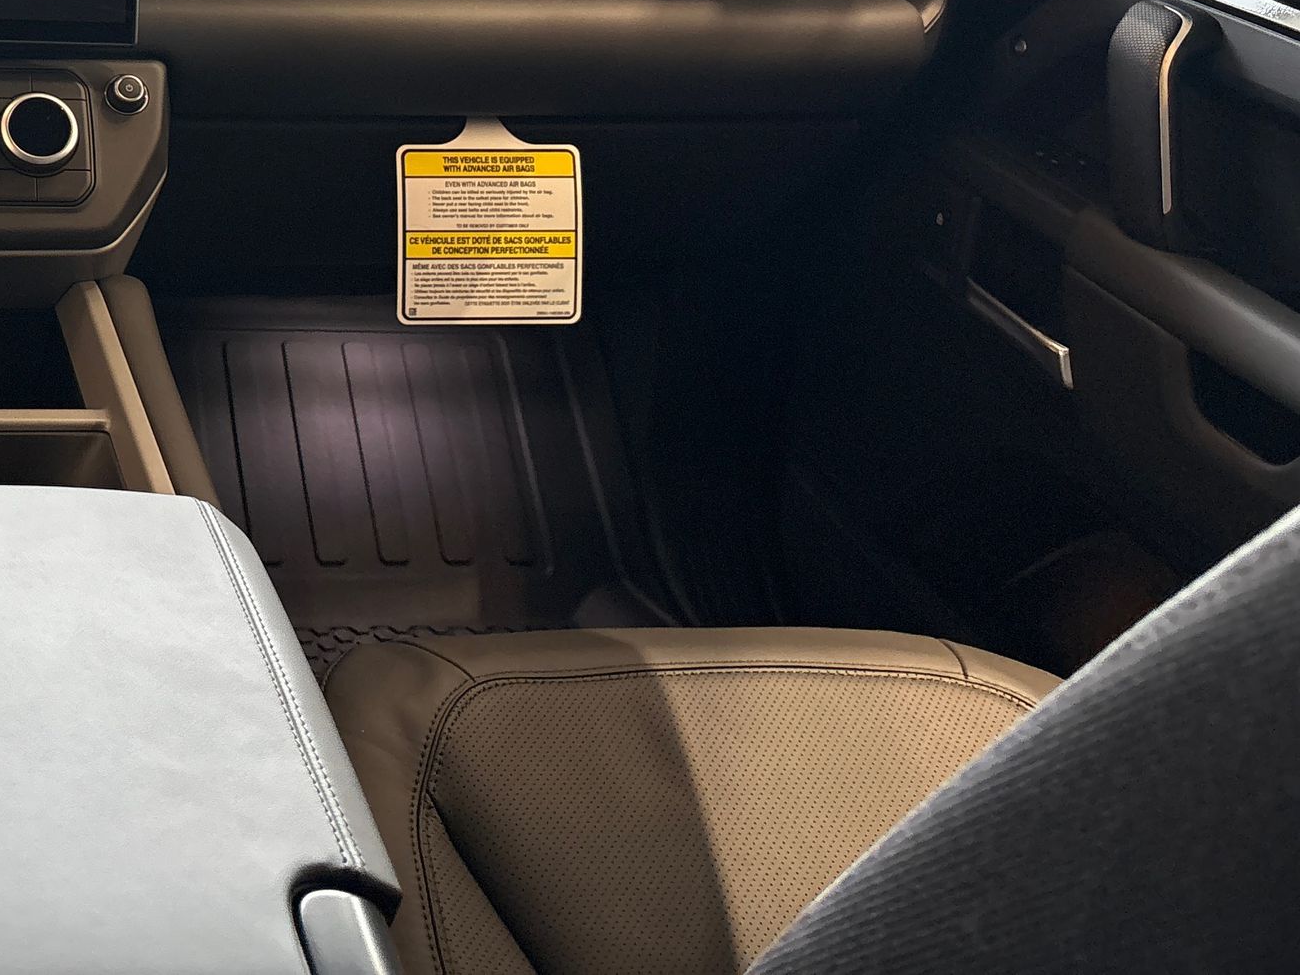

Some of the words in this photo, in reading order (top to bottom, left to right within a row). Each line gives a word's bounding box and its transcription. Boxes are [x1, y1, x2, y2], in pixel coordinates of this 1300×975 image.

[442, 156, 459, 164] THIS
[460, 156, 489, 164] VEHICLE
[491, 156, 498, 164] IS
[499, 156, 534, 164] EQUIPPED
[409, 237, 419, 245] CE
[420, 235, 455, 245] VÉHICULE
[456, 237, 470, 245] EST
[472, 235, 490, 245] DOTÉ
[492, 237, 502, 245] DE
[504, 237, 523, 245] SACS
[524, 237, 571, 245] GONFLABLES
[432, 247, 442, 255] DE
[443, 247, 489, 255] CONCEPTION
[491, 245, 548, 255] PERFECTIONNÉE
